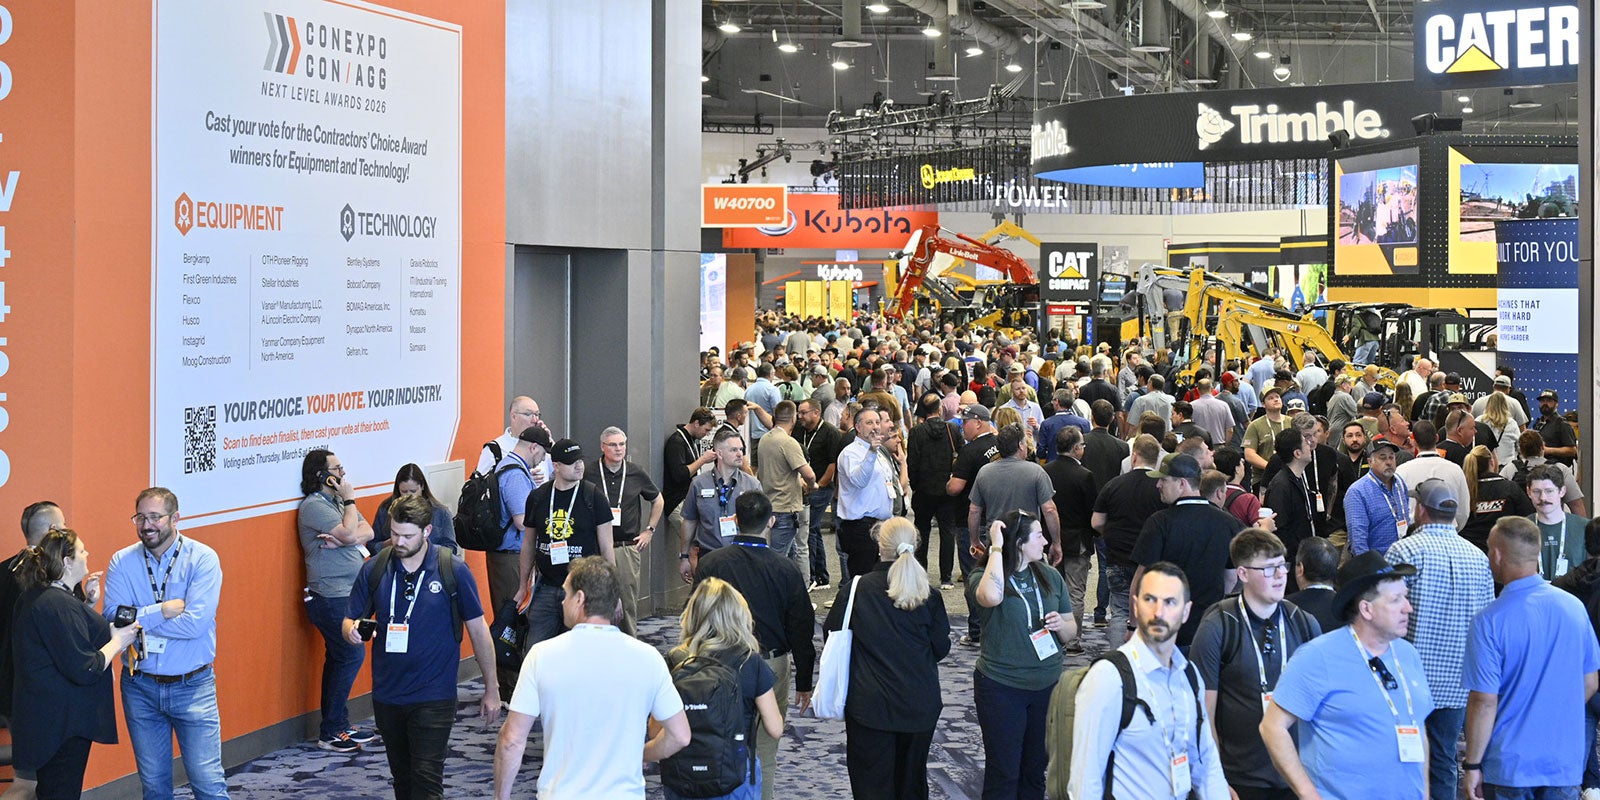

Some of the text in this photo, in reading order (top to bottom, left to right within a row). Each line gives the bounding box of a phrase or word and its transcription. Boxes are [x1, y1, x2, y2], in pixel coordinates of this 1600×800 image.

[306, 21, 387, 60] CONEXPO
[1426, 5, 1579, 74] CATER
[261, 81, 387, 114] NEXT LEVEL AWARDS 2026
[205, 110, 231, 133] Cast
[232, 120, 256, 138] your
[258, 121, 280, 139] vote
[281, 120, 296, 141] for
[297, 123, 312, 143] the
[370, 132, 400, 153] Choice
[401, 136, 428, 156] Award
[230, 146, 410, 183] winners for Equipment and Technology!
[995, 184, 1069, 208] POWER
[714, 197, 776, 210] W40700
[197, 201, 285, 231] EQUIPMENT
[804, 209, 911, 234] Kubota
[358, 212, 437, 239] TECHNOLOGY
[1514, 241, 1540, 262] FOR
[183, 253, 210, 265] Bergkamp
[183, 274, 237, 285] First Green Industries
[277, 278, 299, 288] Industries
[362, 280, 381, 290] Company
[1048, 279, 1090, 290] COMPACT
[183, 294, 200, 305] Flexco
[280, 301, 311, 311] Manufacturing
[1520, 300, 1540, 309] THAT
[183, 315, 200, 325] Husco
[262, 314, 321, 325] A Lincoln Electric Company
[1512, 311, 1531, 320] HARD
[365, 325, 376, 333] North
[377, 324, 393, 333] America
[183, 336, 205, 347] Instagrid
[262, 335, 325, 347] Yanmar Company Equipment
[183, 355, 231, 368] Moog Construction
[261, 351, 294, 361] North America
[1459, 377, 1476, 391] EW
[223, 384, 442, 423] YOUR CHOICE. YOUR VOTE. YOUR INDUSTRY.
[223, 419, 390, 450] Scan to find each finalist, then cast your vote at their booth.
[223, 457, 241, 469] Voting
[241, 454, 255, 467] ends
[256, 452, 280, 466] Thursday,
[282, 449, 298, 460] March
